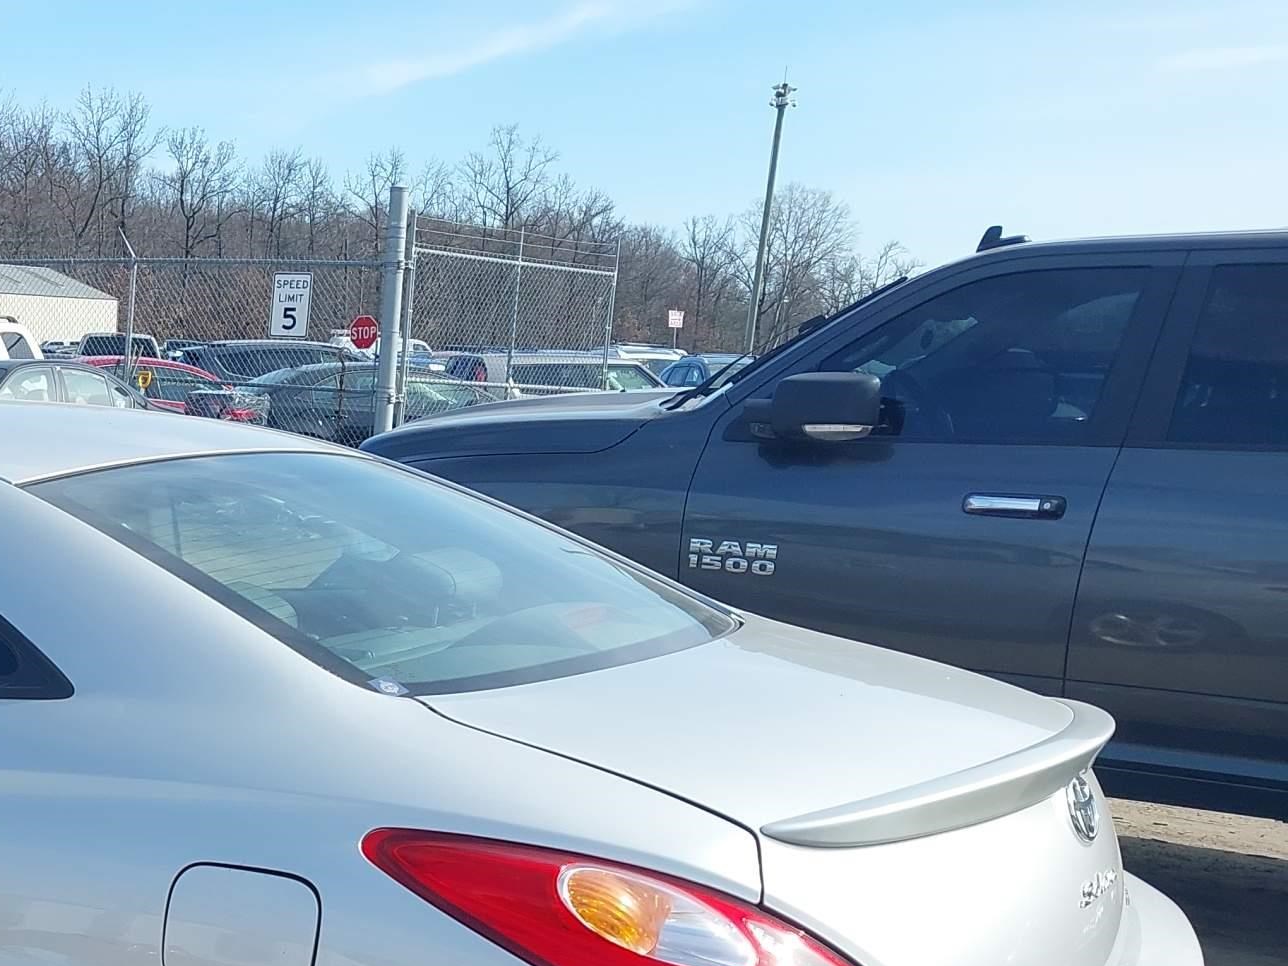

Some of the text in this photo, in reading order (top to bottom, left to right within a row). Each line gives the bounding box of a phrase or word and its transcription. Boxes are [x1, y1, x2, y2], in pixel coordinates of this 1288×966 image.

[276, 279, 309, 289] SPEED
[278, 293, 305, 303] LIMIT
[282, 307, 297, 330] 5
[351, 326, 377, 340] STOP
[689, 538, 778, 560] RAM
[688, 553, 775, 576] 1500
